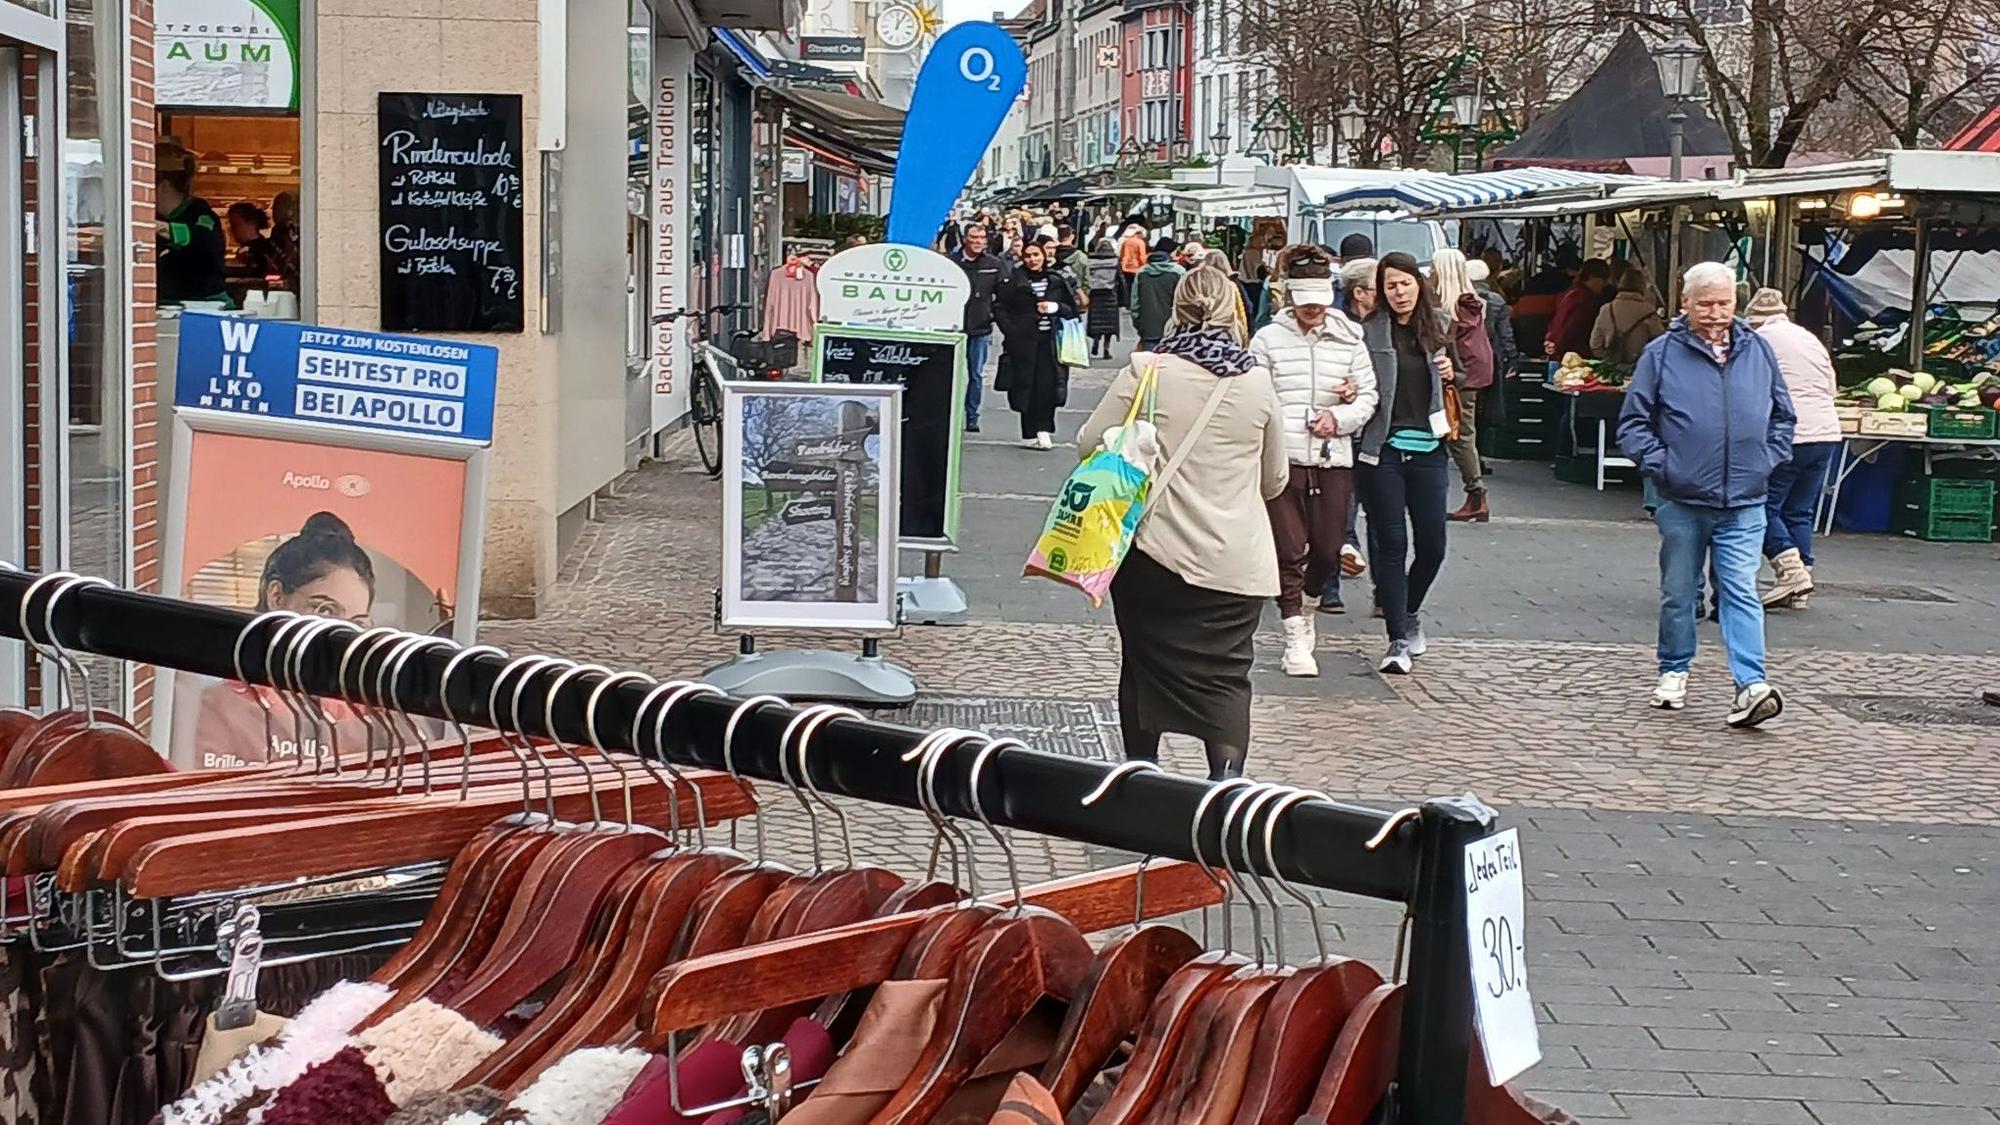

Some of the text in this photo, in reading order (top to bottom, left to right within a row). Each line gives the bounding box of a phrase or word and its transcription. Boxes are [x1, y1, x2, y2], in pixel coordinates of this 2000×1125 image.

[166, 41, 271, 62] AUM
[656, 77, 675, 169] Tradition
[659, 178, 674, 215] aus
[385, 223, 504, 266] Gulaschsuppe
[655, 223, 674, 276] Haus
[655, 285, 673, 310] im
[842, 285, 943, 304] BAUM
[299, 330, 469, 360] JETZT ZUM KOSTENLOSEN
[304, 356, 460, 390] SEHTEST PRO
[302, 390, 456, 427] BEI APOLLO
[282, 471, 330, 489] Apollo
